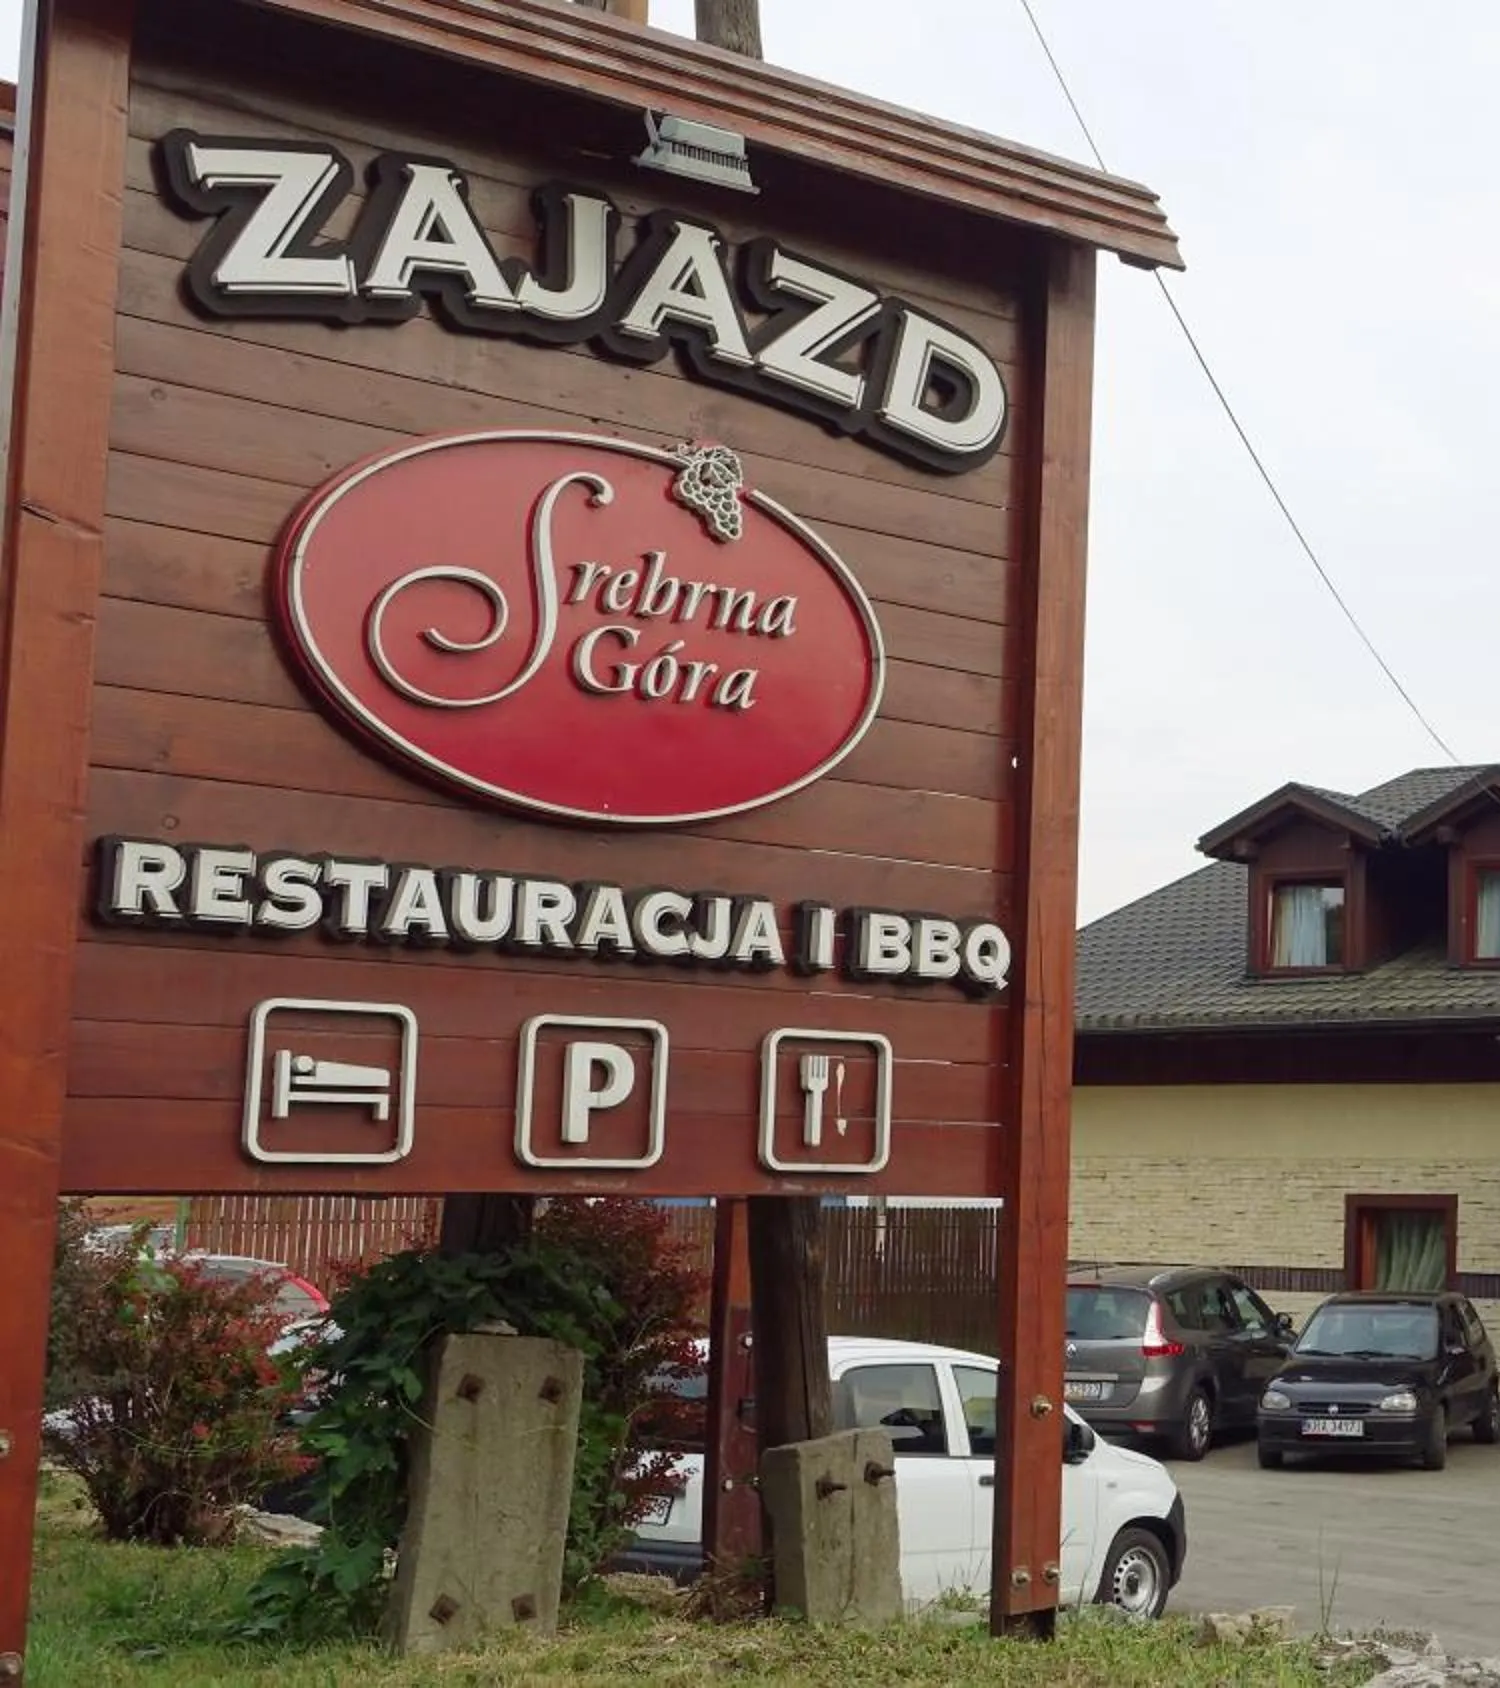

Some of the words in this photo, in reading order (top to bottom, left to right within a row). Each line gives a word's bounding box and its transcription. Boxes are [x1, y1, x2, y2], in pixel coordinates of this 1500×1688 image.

[186, 139, 1006, 455] ZAJAZD
[368, 472, 798, 708] Srebrna
[573, 624, 761, 710] Góra
[112, 841, 786, 966] RESTAURACJA
[809, 906, 837, 969] I
[859, 912, 1010, 991] BBQ
[561, 1041, 635, 1144] P
